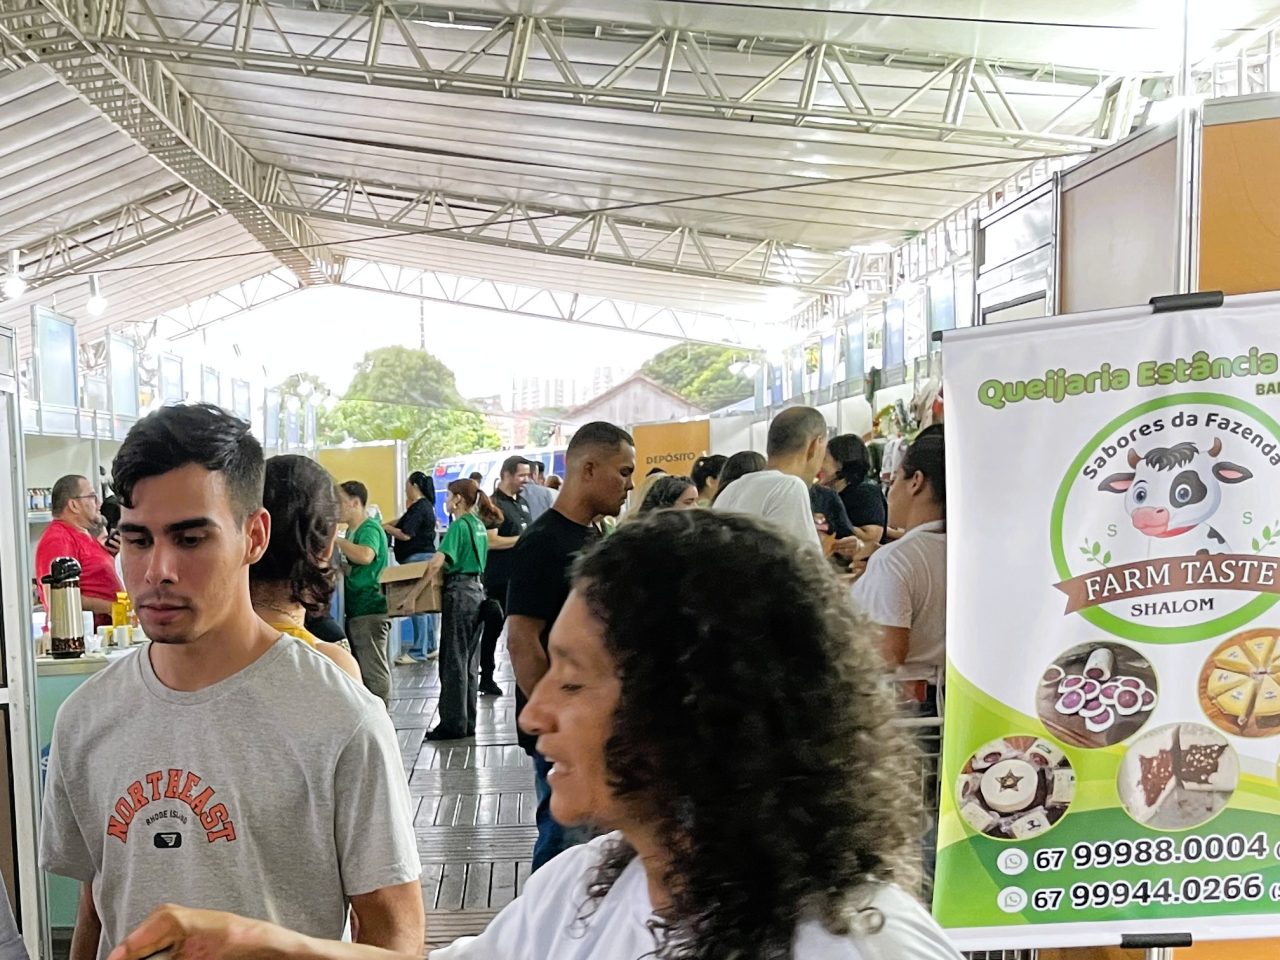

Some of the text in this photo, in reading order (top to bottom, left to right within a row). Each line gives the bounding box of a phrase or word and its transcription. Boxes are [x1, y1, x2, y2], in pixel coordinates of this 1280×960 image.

[978, 346, 1279, 409] Queijaria Estância
[1256, 382, 1280, 396] BA
[646, 451, 696, 465] DEPÓSITO
[1083, 412, 1280, 480] Sabores da Fazenda
[1107, 524, 1118, 537] S
[1242, 512, 1253, 525] S
[1084, 559, 1278, 601] FARM TASTE
[1131, 598, 1214, 617] SHALOM
[107, 768, 237, 844] NORTHEAST
[146, 810, 168, 826] RHODE
[1035, 850, 1065, 869] 67
[1073, 834, 1267, 868] 99988.0004
[1033, 890, 1063, 909] 67
[1071, 876, 1261, 907] 99944.0266
